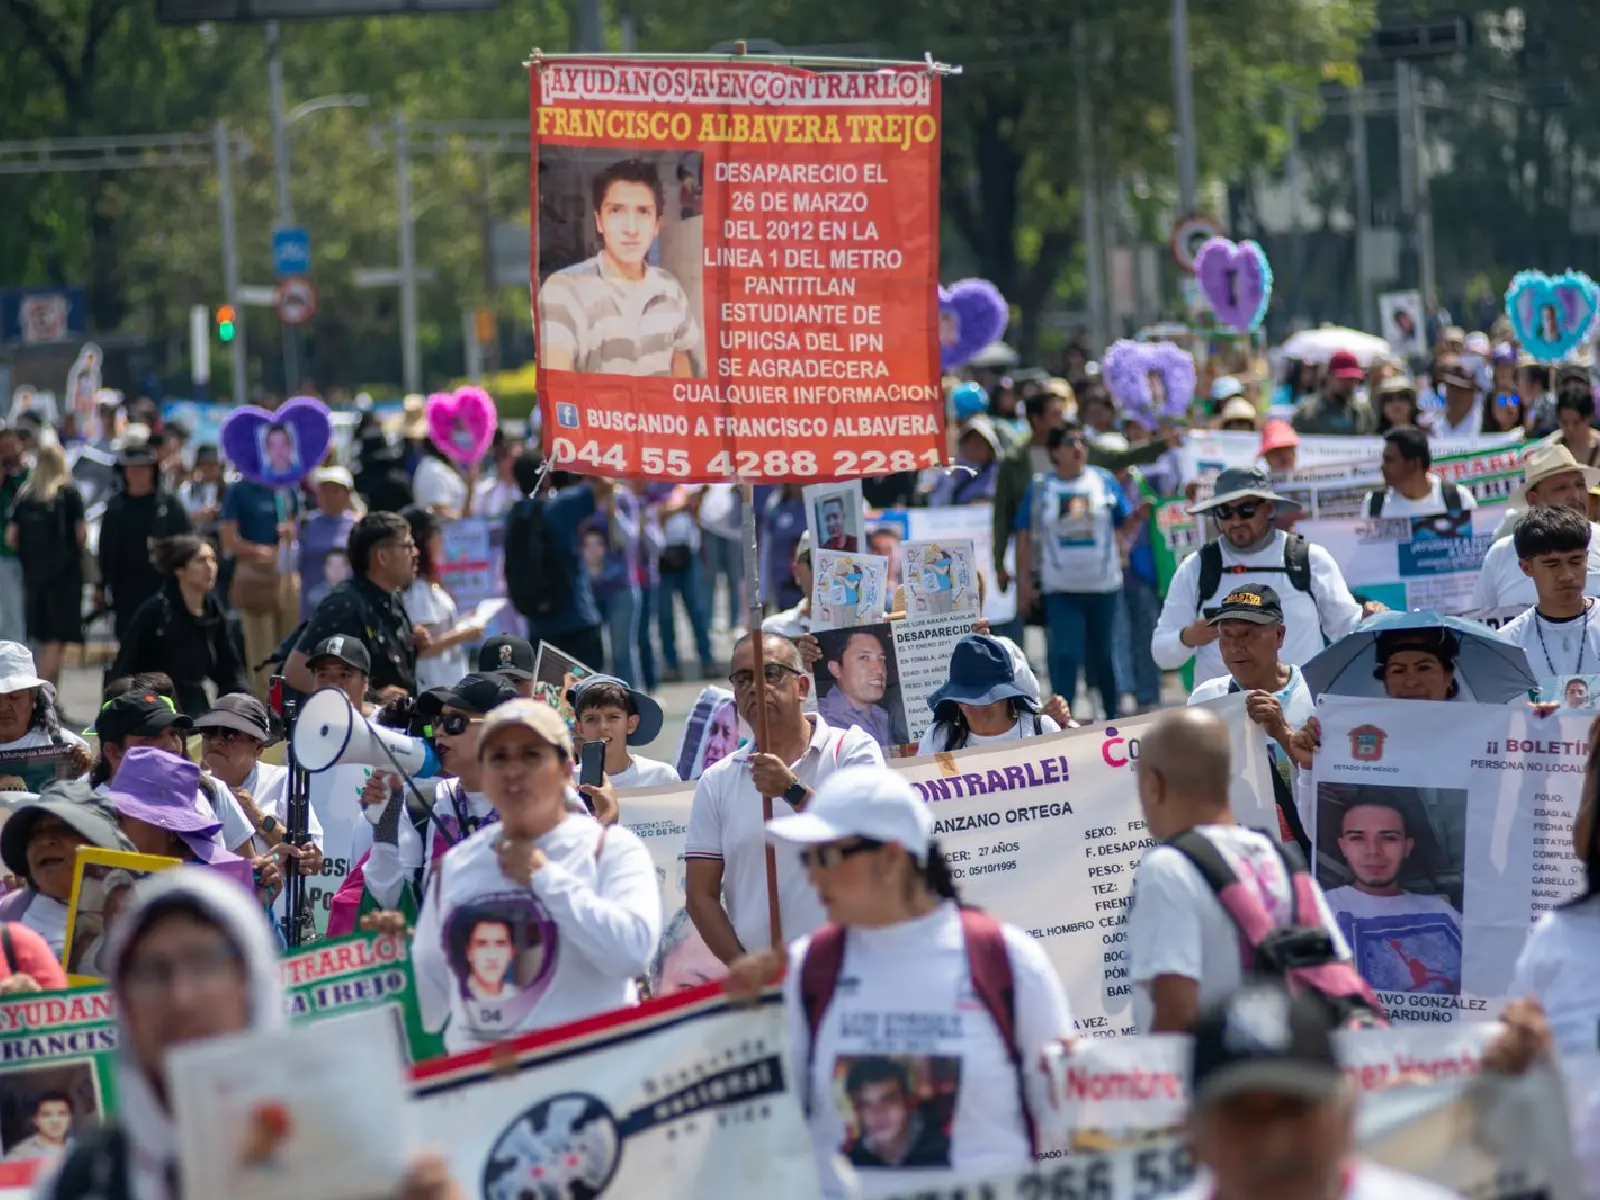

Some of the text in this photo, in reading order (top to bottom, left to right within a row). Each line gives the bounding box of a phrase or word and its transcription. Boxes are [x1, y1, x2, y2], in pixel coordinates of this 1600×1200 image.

[691, 71, 710, 98] A
[715, 71, 929, 99] ENCONTRARLO!
[537, 107, 937, 151] FRANCISCO ALBAVERA TREJO
[715, 162, 888, 184] DESAPARECIO EL
[731, 191, 869, 213] 26 DE MARZO
[724, 220, 879, 241] DEL 2012 EN LA
[703, 247, 903, 270] LINEA 1 DEL METRO
[744, 276, 856, 297] PANTITLAN
[721, 302, 882, 325] ESTUDIANTE DE
[719, 330, 884, 353] UPIICSA DEL IPN
[718, 357, 890, 380] SE AGRADECERA
[673, 384, 939, 406] CUALQUIER INFORMACION
[586, 408, 689, 437] BUSCANDO
[694, 416, 710, 437] A
[714, 416, 828, 438] FRANCISCO
[832, 413, 941, 438] ALBAVERA
[551, 437, 941, 477] 044 55 4288 2281
[1470, 759, 1524, 771] PERSONA
[1526, 761, 1543, 772] NO
[931, 801, 1073, 835] ANZANO ORTEGA
[1085, 825, 1117, 840] SEXO:
[978, 846, 990, 857] 27
[991, 841, 1020, 854] AÑOS
[1088, 864, 1125, 878] PESO:
[1092, 882, 1118, 896] TEZ:
[1047, 920, 1095, 936] HOMBRO
[0, 994, 115, 1030] YUDAN
[1408, 994, 1487, 1011] GONZÁLEZ
[1083, 1016, 1108, 1029] VEZ:
